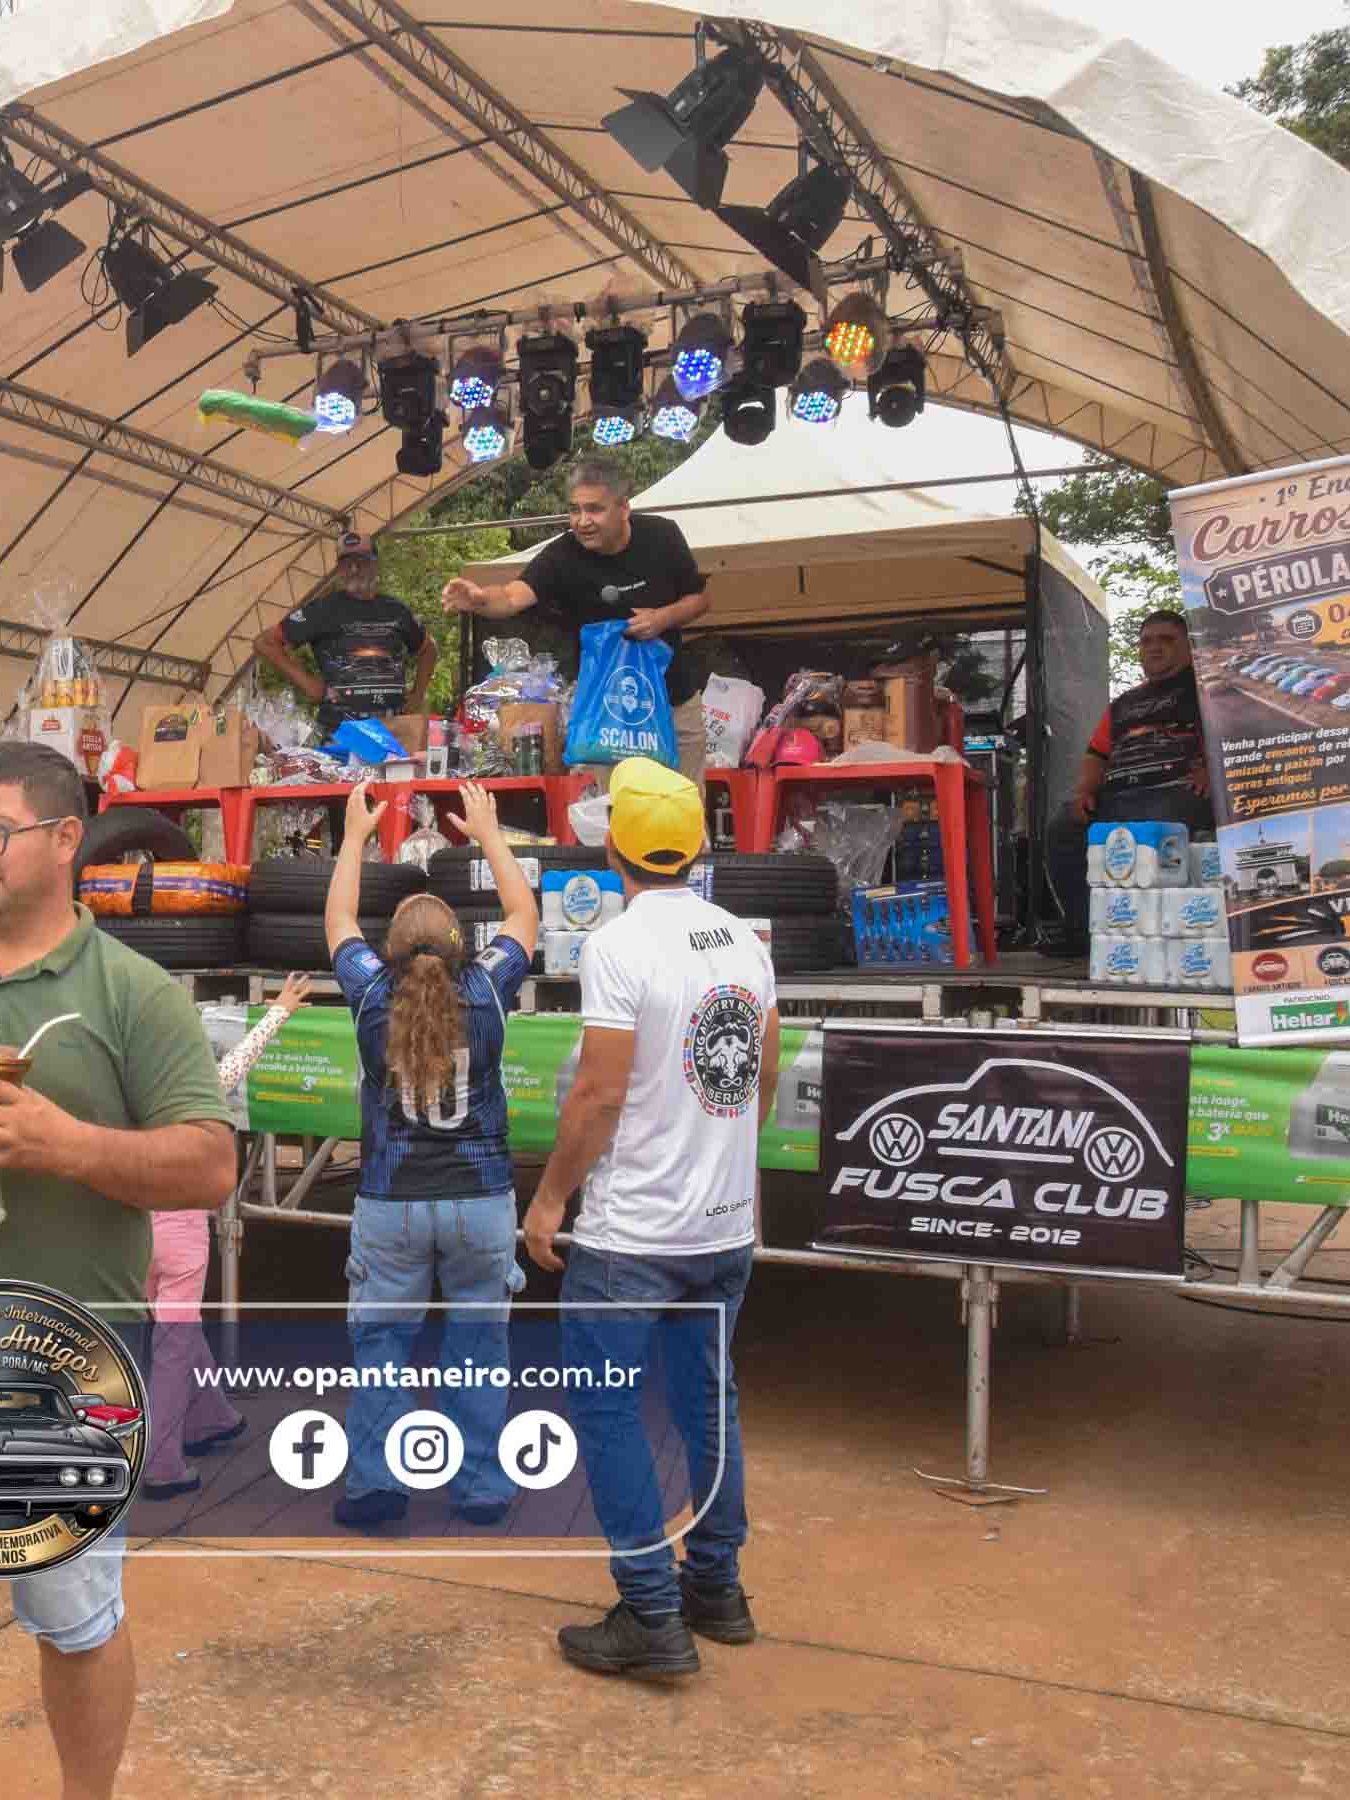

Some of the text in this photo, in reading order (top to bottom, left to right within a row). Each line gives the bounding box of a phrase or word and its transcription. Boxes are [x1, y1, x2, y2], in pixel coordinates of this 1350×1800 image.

[600, 728, 658, 751] SCALON
[1221, 727, 1348, 752] Venha participar desse
[1224, 751, 1262, 768] grande
[1318, 741, 1332, 752] de
[1326, 754, 1346, 767] por
[689, 927, 735, 952] ADRIAN
[1273, 1011, 1336, 1030] Heliar
[928, 1104, 1094, 1150] SANTANI
[830, 1167, 1169, 1220] FUSCA CLUB
[1010, 1225, 1081, 1245] 2012
